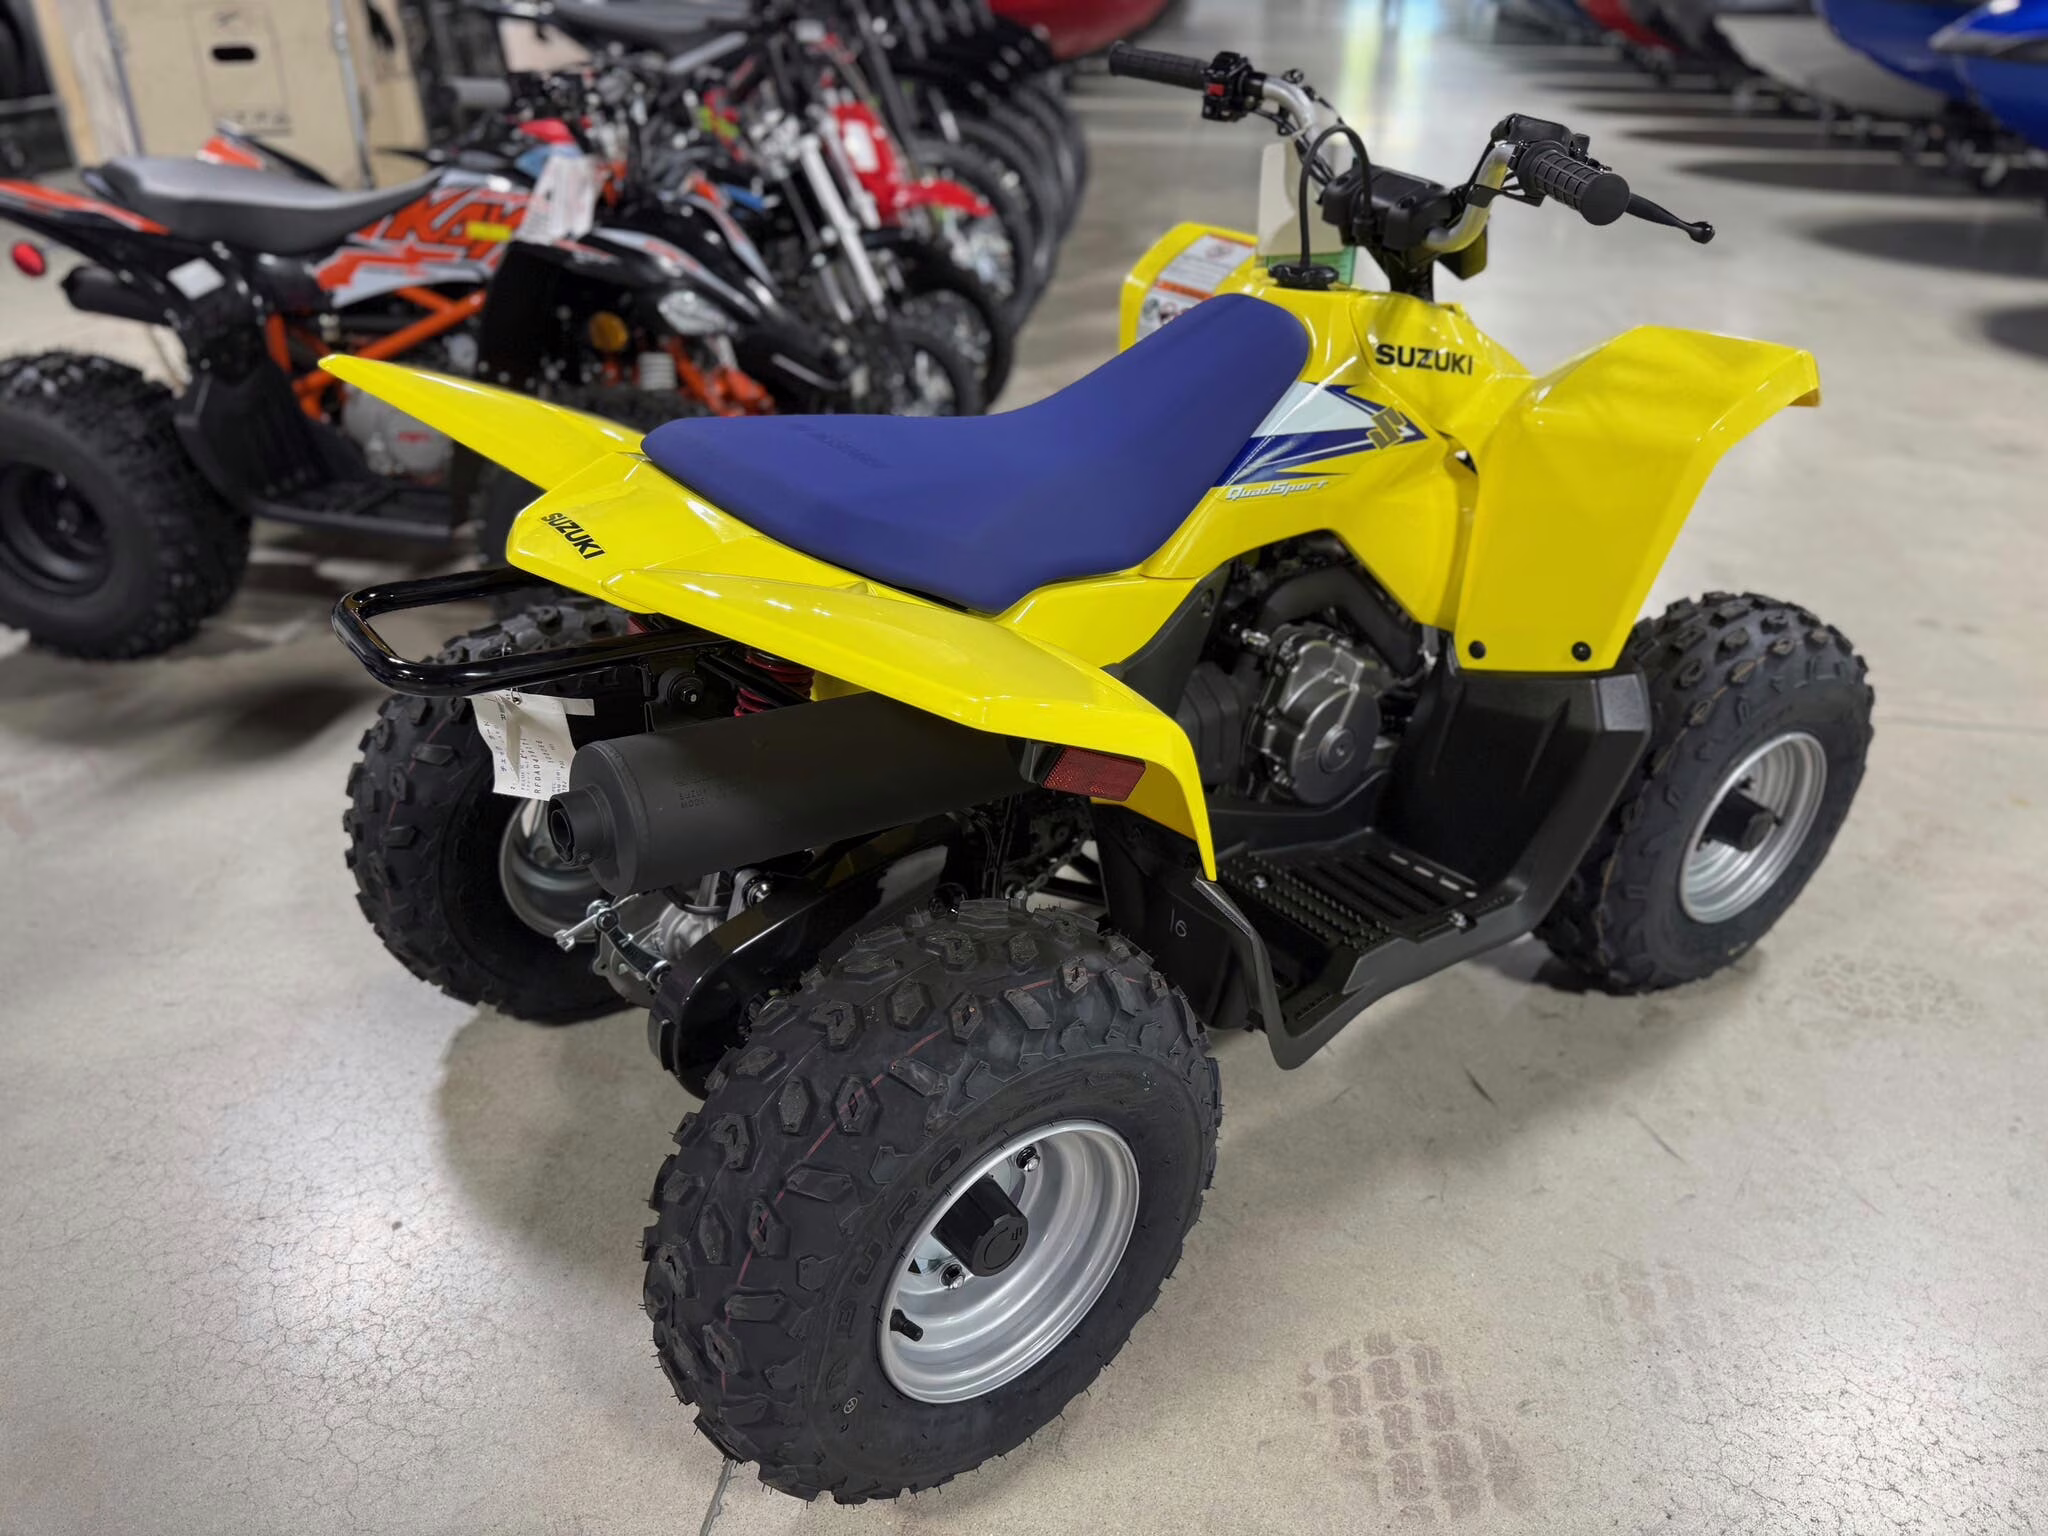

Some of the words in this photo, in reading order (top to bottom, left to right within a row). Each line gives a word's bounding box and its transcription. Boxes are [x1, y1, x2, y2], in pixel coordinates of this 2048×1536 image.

[1375, 343, 1474, 376] SUZUKI
[1226, 480, 1328, 501] QuadSport
[540, 512, 606, 560] SUZUKI
